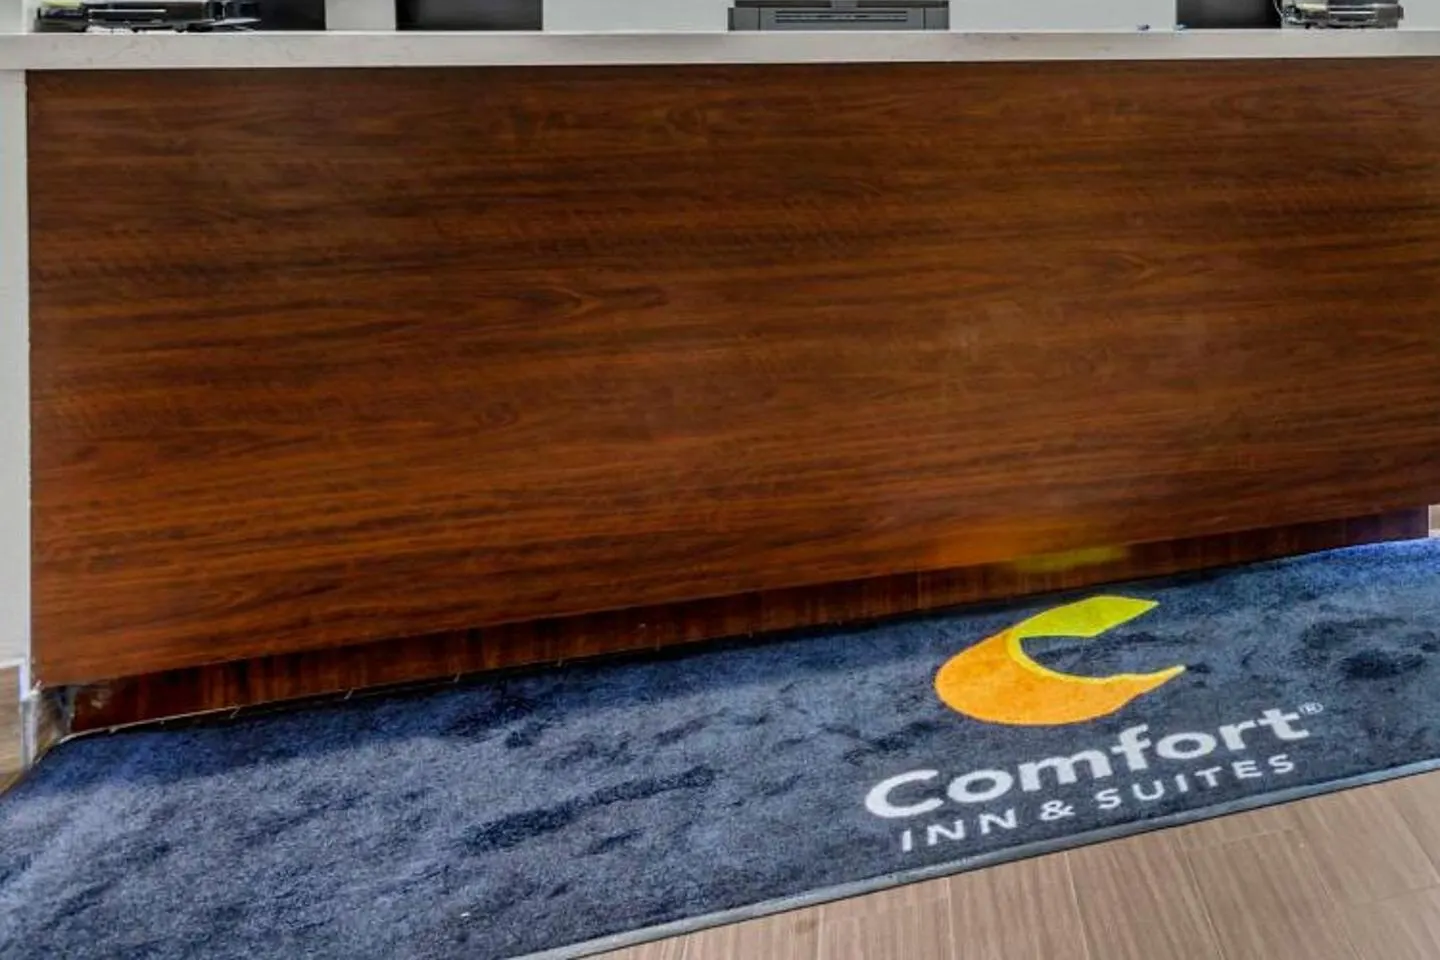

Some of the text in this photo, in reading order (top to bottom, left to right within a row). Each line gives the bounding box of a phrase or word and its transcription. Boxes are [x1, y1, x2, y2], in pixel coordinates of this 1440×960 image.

[901, 753, 1296, 852] INN & SUITES
